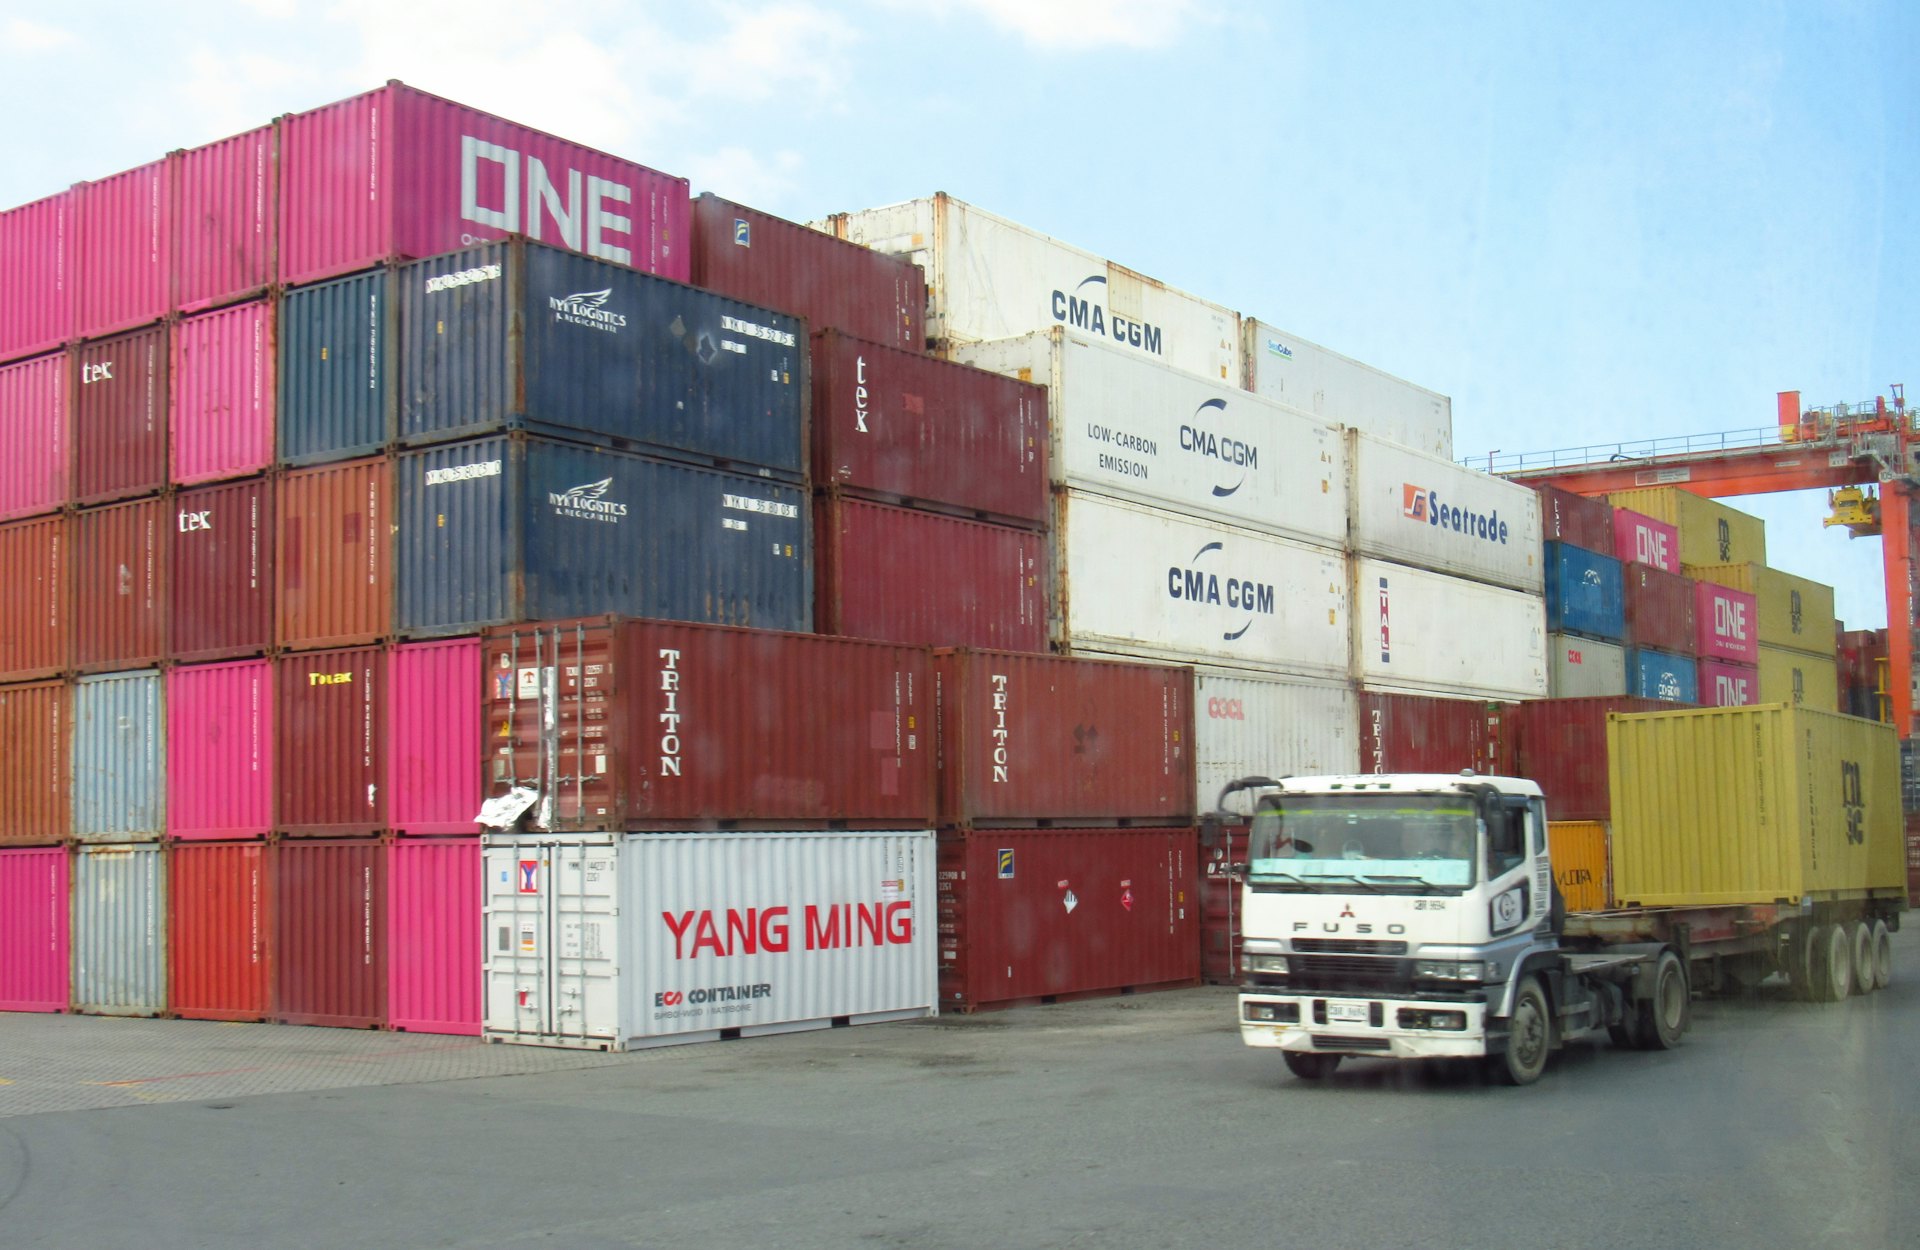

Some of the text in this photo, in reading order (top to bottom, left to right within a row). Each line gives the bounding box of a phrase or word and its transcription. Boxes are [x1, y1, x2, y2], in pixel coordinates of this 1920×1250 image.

[461, 135, 631, 265] ONE
[549, 296, 627, 327] NYK LOGISTICS
[1052, 290, 1161, 355] CMA CGM
[855, 355, 868, 432] tex
[1087, 423, 1157, 456] LOW-CARBON
[1179, 425, 1258, 470] CMA CGM
[1099, 453, 1148, 479] EMISSION
[549, 492, 627, 516] NYK LOGISTICS
[1429, 491, 1508, 545] Seatrade
[1636, 525, 1668, 570] ONE
[1168, 567, 1274, 614] CMA CGM
[1380, 593, 1389, 649] TAL
[1714, 596, 1746, 640] ONE
[659, 648, 681, 777] TRITON
[1716, 675, 1747, 706] ONE
[991, 675, 1009, 783] TRITON
[662, 906, 789, 960] YANG
[804, 900, 911, 951] MING
[1292, 922, 1406, 935] FUSO
[688, 983, 771, 1004] CONTAINER
